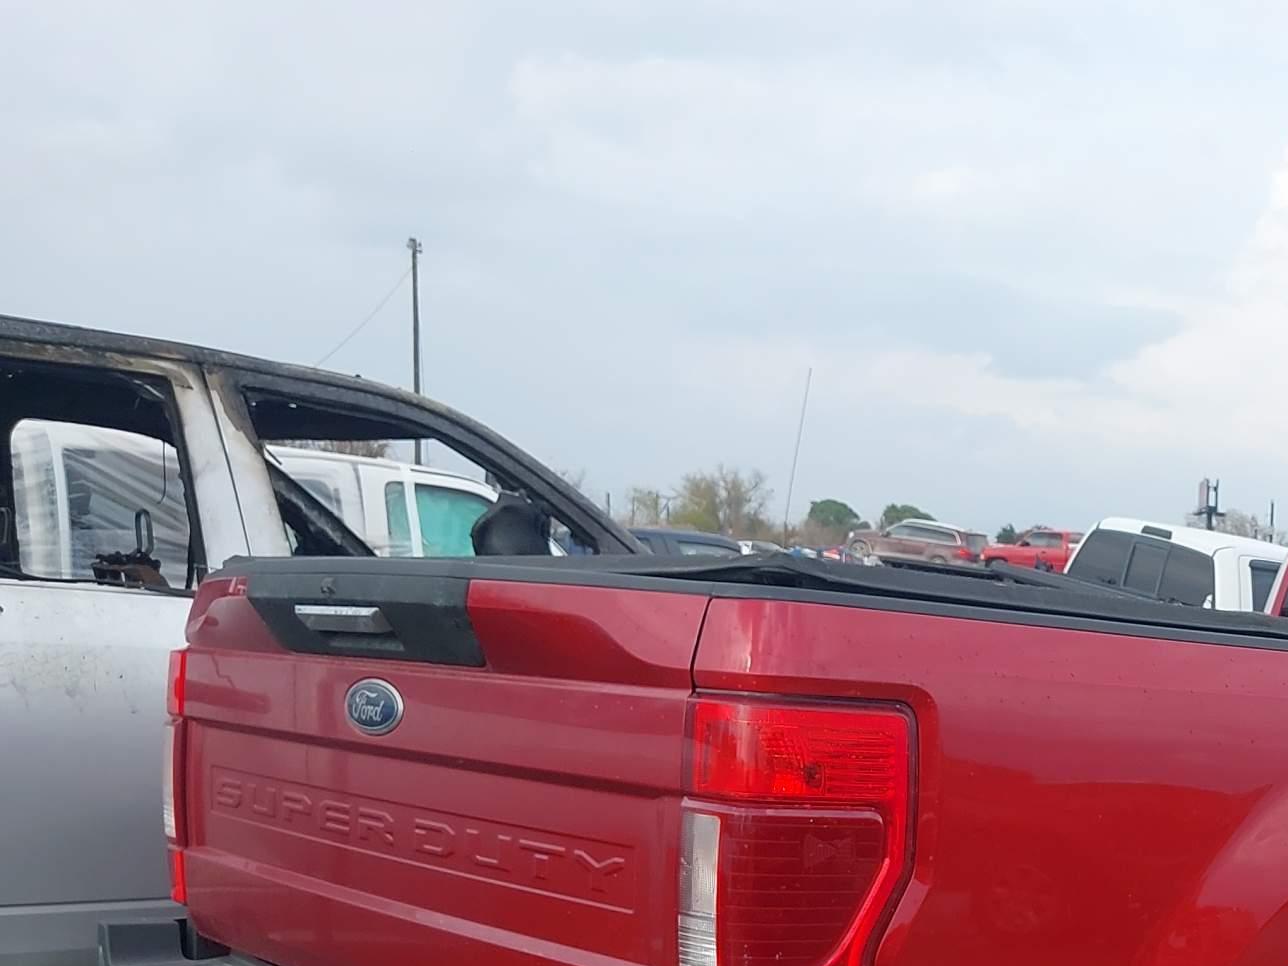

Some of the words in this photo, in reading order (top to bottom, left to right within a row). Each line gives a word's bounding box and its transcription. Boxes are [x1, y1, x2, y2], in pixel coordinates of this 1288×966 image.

[352, 689, 385, 722] Ford
[215, 777, 395, 848] SUPER
[412, 816, 627, 894] DUTY
